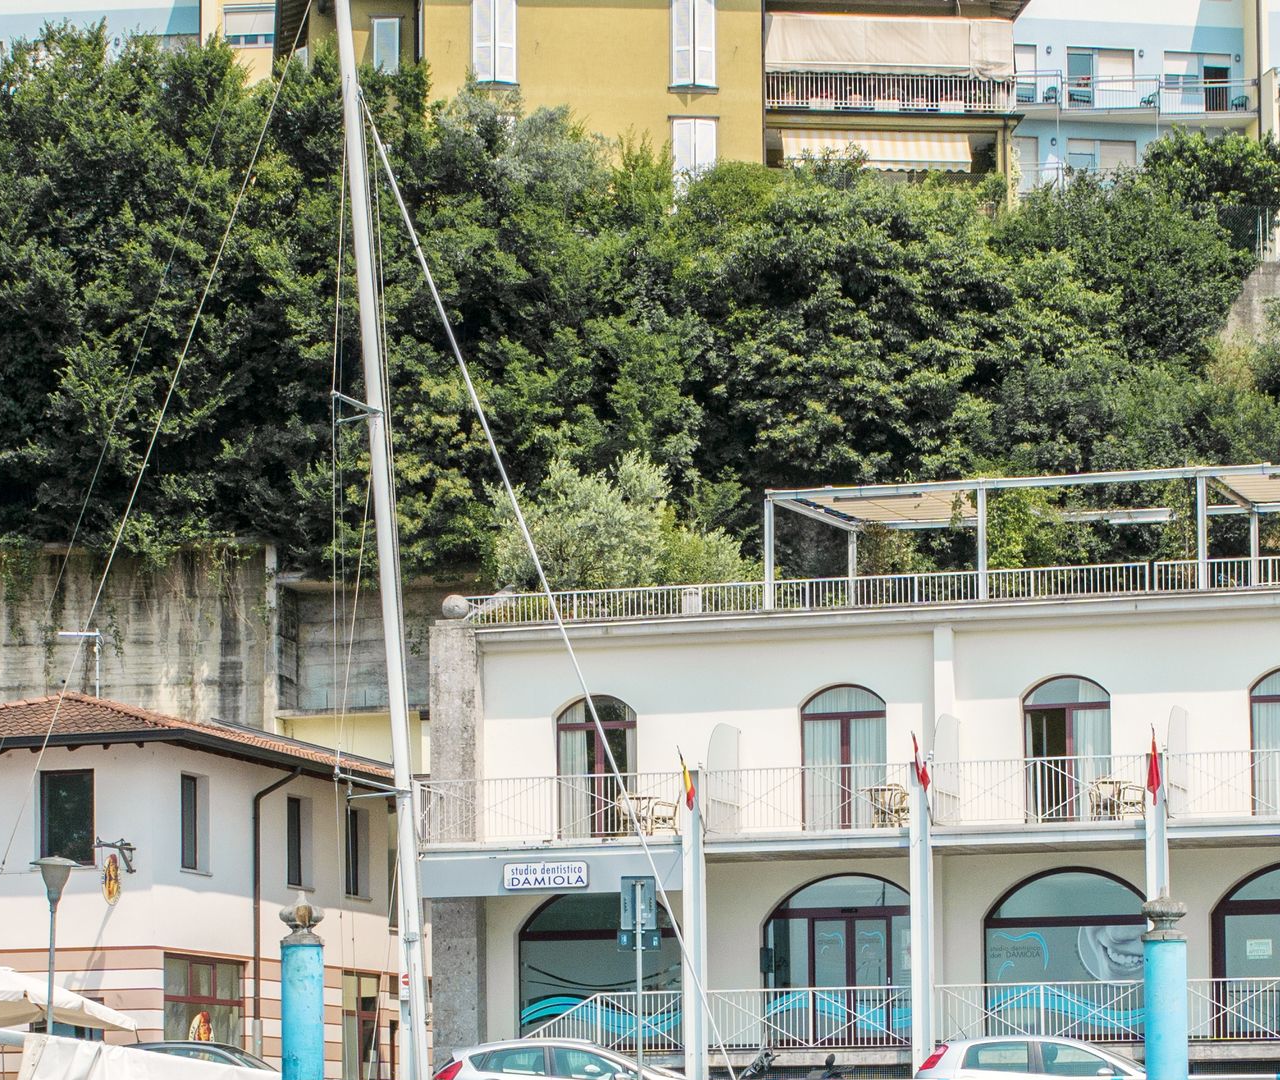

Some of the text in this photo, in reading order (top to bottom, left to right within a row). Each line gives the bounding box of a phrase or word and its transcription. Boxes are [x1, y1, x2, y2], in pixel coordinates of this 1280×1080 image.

[511, 863, 583, 876] studio dentistico
[511, 875, 585, 887] DAMIOLA
